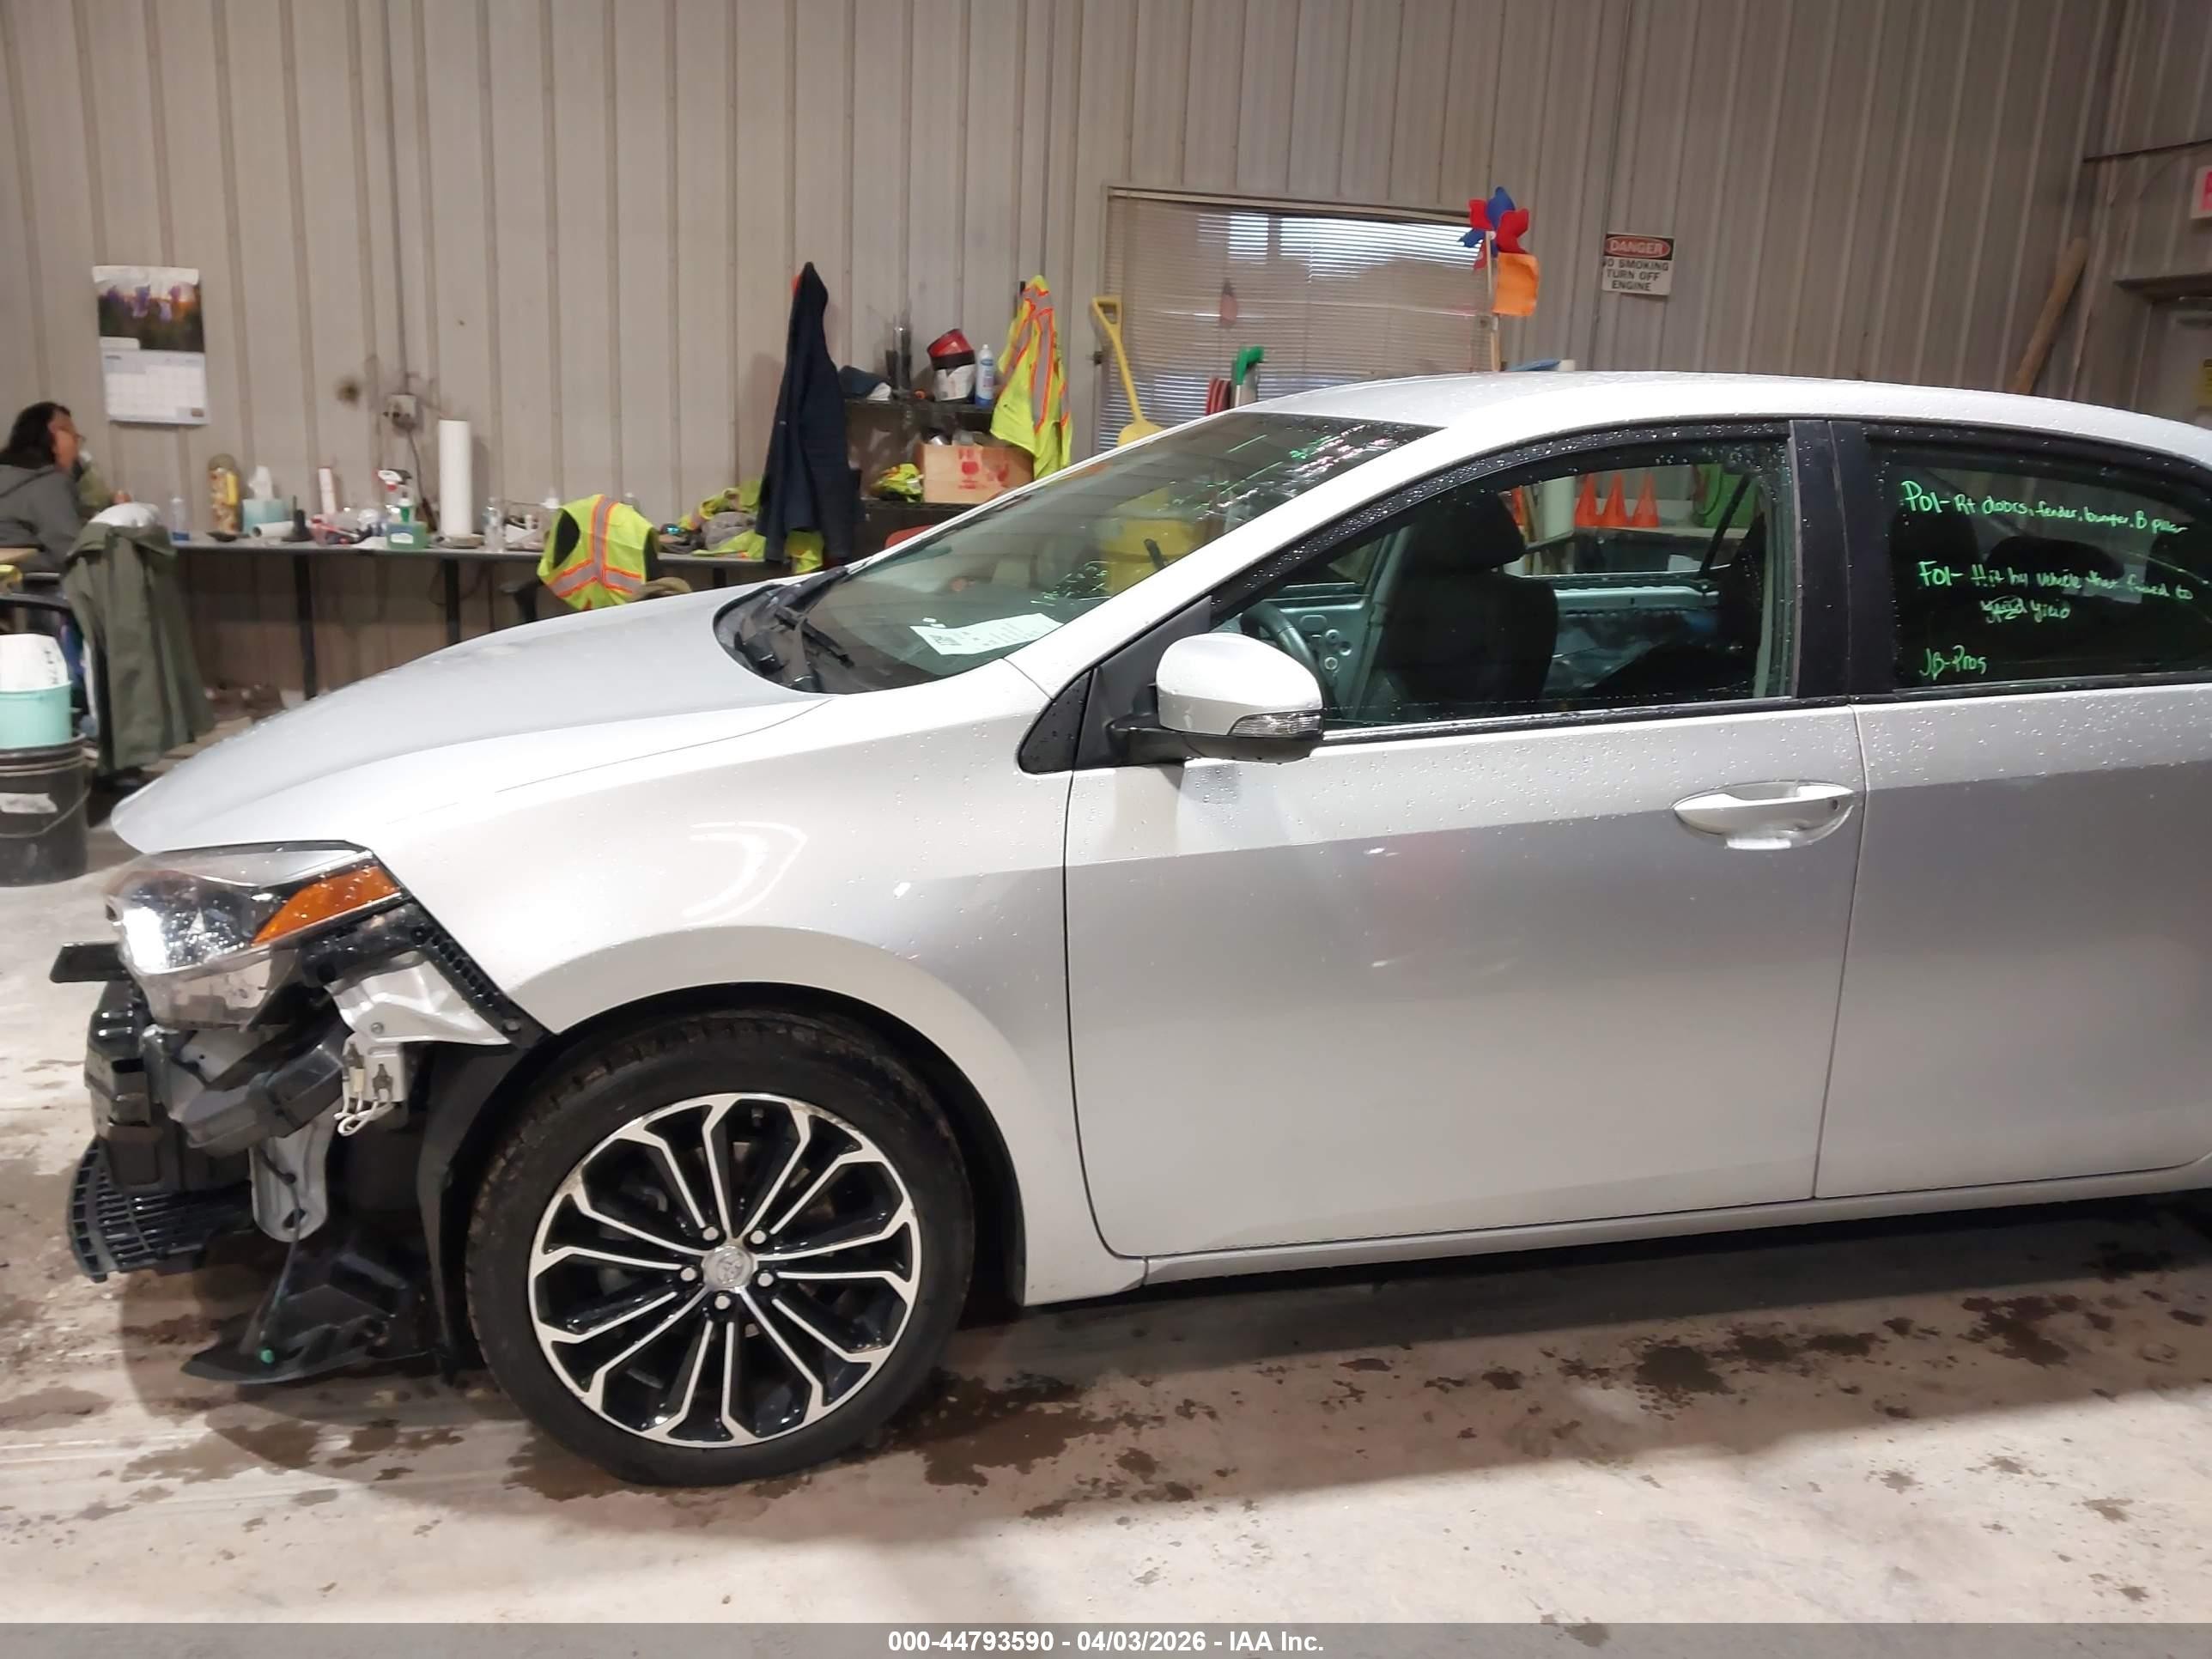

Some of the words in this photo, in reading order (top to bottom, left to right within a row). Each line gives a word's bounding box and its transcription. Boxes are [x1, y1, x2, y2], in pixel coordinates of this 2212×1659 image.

[1610, 240, 1663, 254] DANGER
[1619, 259, 1668, 270] SMOKING
[1607, 268, 1635, 279] TURN
[1638, 270, 1661, 281] OFF
[1612, 280, 1651, 291] ENGINE
[2135, 510, 2148, 529] B
[2175, 584, 2194, 600] to
